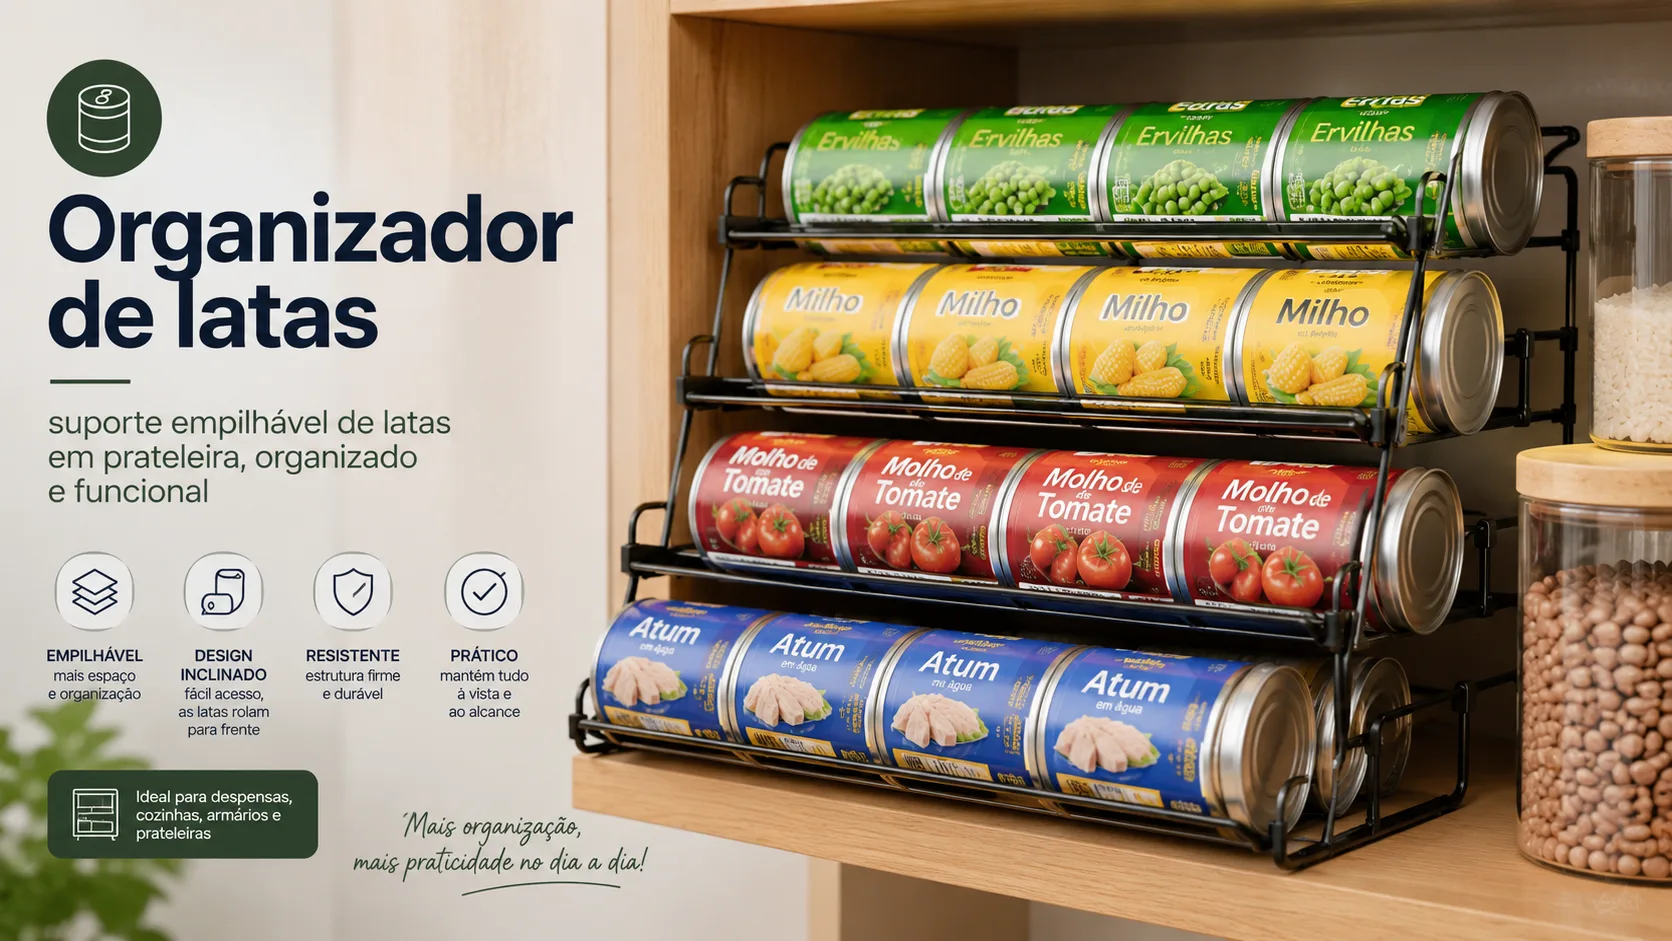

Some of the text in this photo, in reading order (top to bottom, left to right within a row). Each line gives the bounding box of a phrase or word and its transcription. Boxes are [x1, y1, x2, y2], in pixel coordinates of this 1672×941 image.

[816, 129, 902, 152] Ervilhas
[968, 127, 1064, 149] Ervilhas
[1136, 124, 1233, 146] Ervilhas
[1310, 120, 1416, 143] Ervilhas
[784, 286, 864, 314] Milho
[936, 289, 1021, 321] Milho
[1099, 293, 1189, 324] Milho
[1275, 298, 1370, 328] Milho
[728, 446, 818, 471] Molho de
[881, 456, 973, 482] Molho de
[723, 468, 804, 498] Tomate
[875, 479, 961, 511] Tomate
[1043, 467, 1143, 494] Molho de
[1221, 479, 1332, 508] Molho de
[1038, 492, 1131, 525] Tomate
[1217, 505, 1320, 540] Tomate
[629, 616, 702, 645] Atum
[769, 632, 846, 663] Atum
[918, 650, 1000, 682] Atum
[1080, 670, 1172, 704] Atum
[1095, 700, 1113, 711] em
